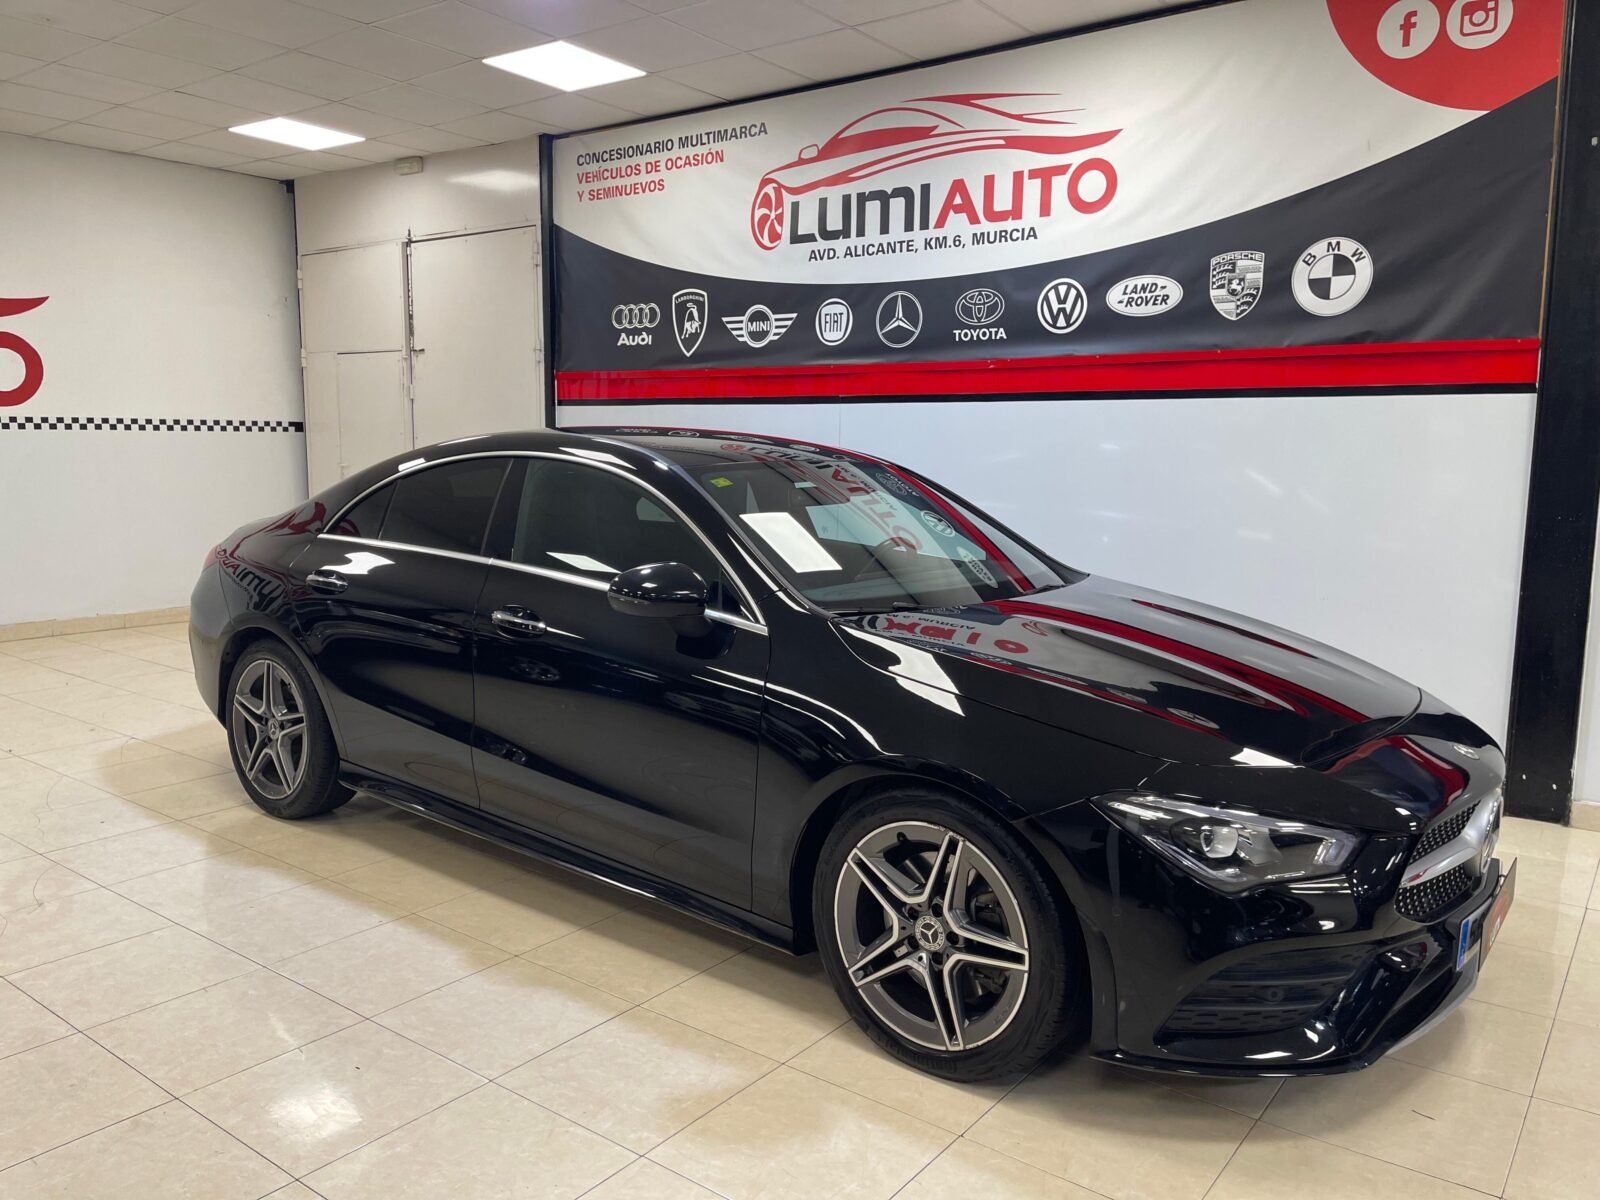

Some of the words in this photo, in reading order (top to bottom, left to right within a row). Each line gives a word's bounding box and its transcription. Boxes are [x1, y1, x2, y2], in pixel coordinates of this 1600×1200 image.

[576, 138, 675, 167] CONCESIONARIO
[677, 122, 769, 150] MULTIMARCA
[576, 163, 642, 185] VEHÍCULOS
[644, 160, 662, 175] DE
[664, 148, 725, 171] OCASIÓN
[577, 190, 585, 202] Y
[588, 178, 666, 201] SEMINUEVOS
[808, 247, 840, 262] AVD.
[843, 240, 919, 259] ALICANTE,
[923, 234, 966, 251] KM.6,
[970, 226, 1039, 246] MURCIA
[1302, 240, 1366, 267] BMW
[1212, 252, 1264, 266] PORSCHE
[747, 320, 771, 333] MINI
[823, 311, 845, 333] FIAT
[616, 331, 652, 346] Audi
[953, 327, 1007, 342] TOYOTA
